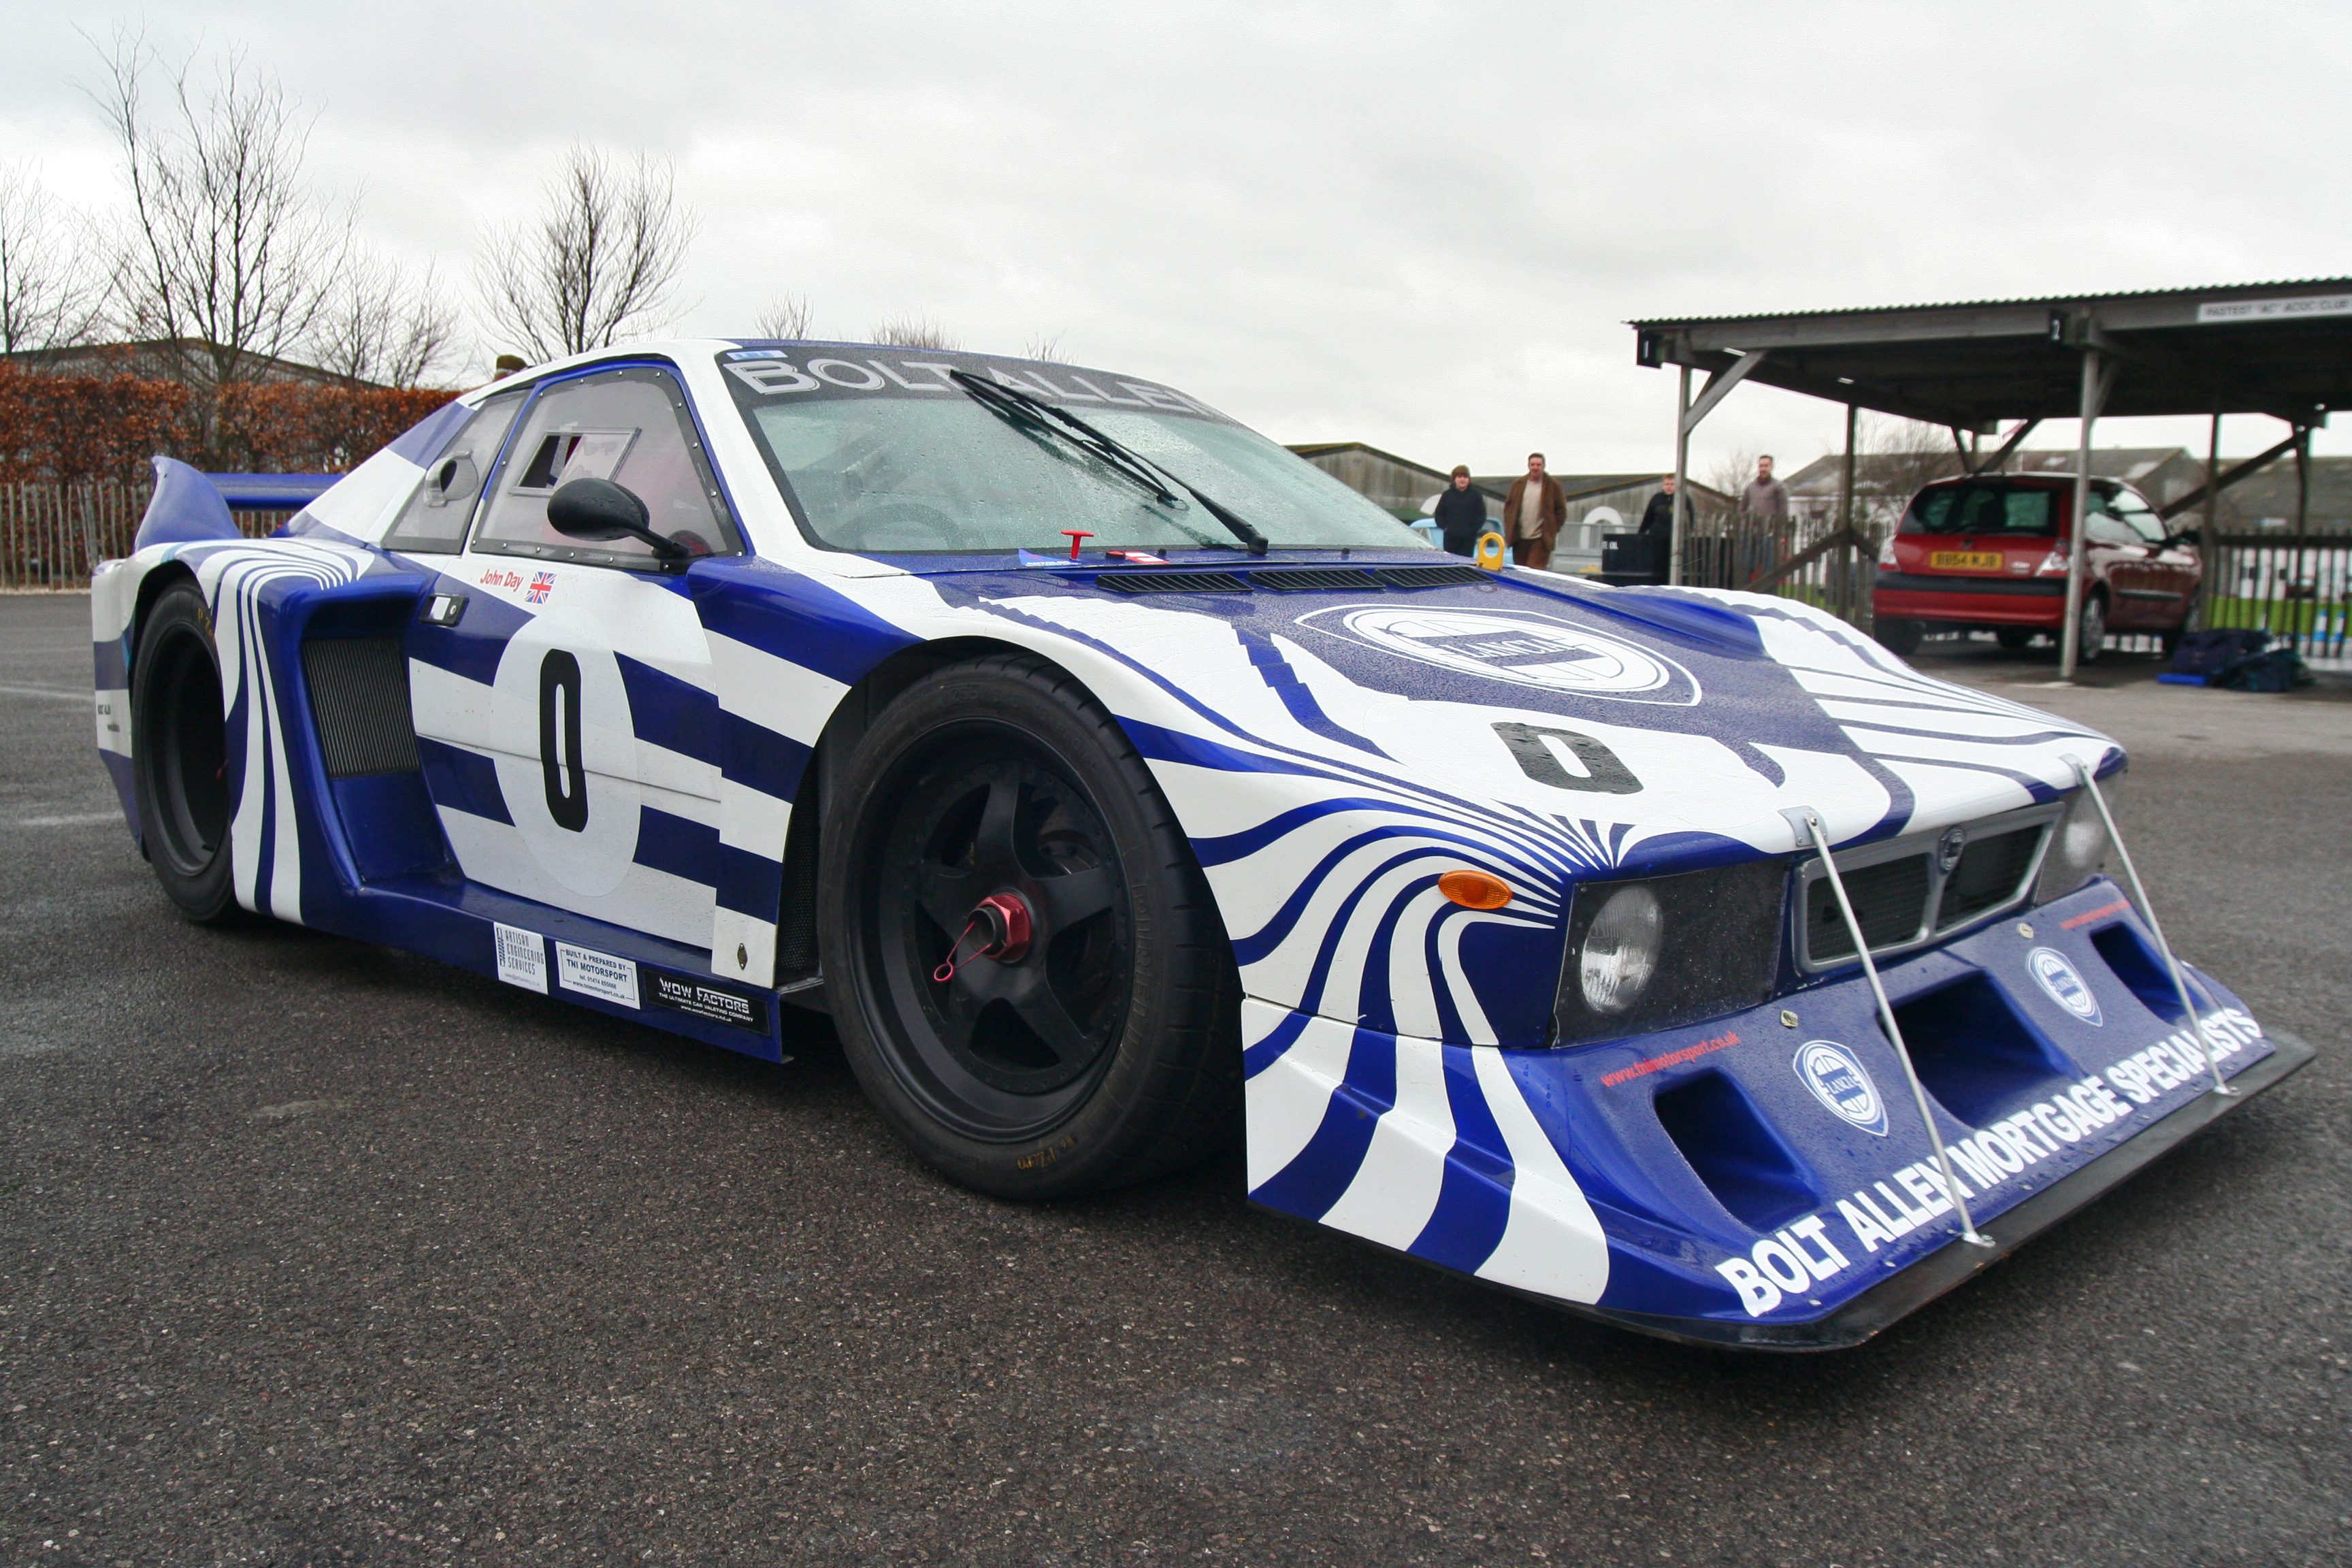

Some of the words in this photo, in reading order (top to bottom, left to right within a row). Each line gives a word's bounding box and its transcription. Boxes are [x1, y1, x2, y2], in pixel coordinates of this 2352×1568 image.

[723, 358, 973, 395] BOLT
[480, 569, 503, 586] John
[504, 572, 524, 592] Day
[1439, 638, 1577, 658] LANCIA
[540, 649, 589, 832] 0
[1490, 721, 1644, 794] 0
[505, 930, 529, 947] ARTISAN
[506, 943, 544, 964] ENGINEERING
[566, 949, 581, 958] BUILT
[589, 956, 617, 968] PREPARED
[508, 957, 536, 975] SERVICES
[566, 959, 578, 968] TNI
[581, 962, 627, 982] MOTORSPORT
[659, 977, 692, 998] WOW
[696, 987, 750, 1014] FACTORS
[668, 995, 692, 1005] ULTIMATE
[704, 1004, 728, 1015] VALETING
[728, 1011, 754, 1022] COMPANY
[1715, 1215, 1850, 1318] BOLT
[1835, 1156, 1976, 1252] ALLEN
[1947, 1075, 2134, 1190] MORTGAGE
